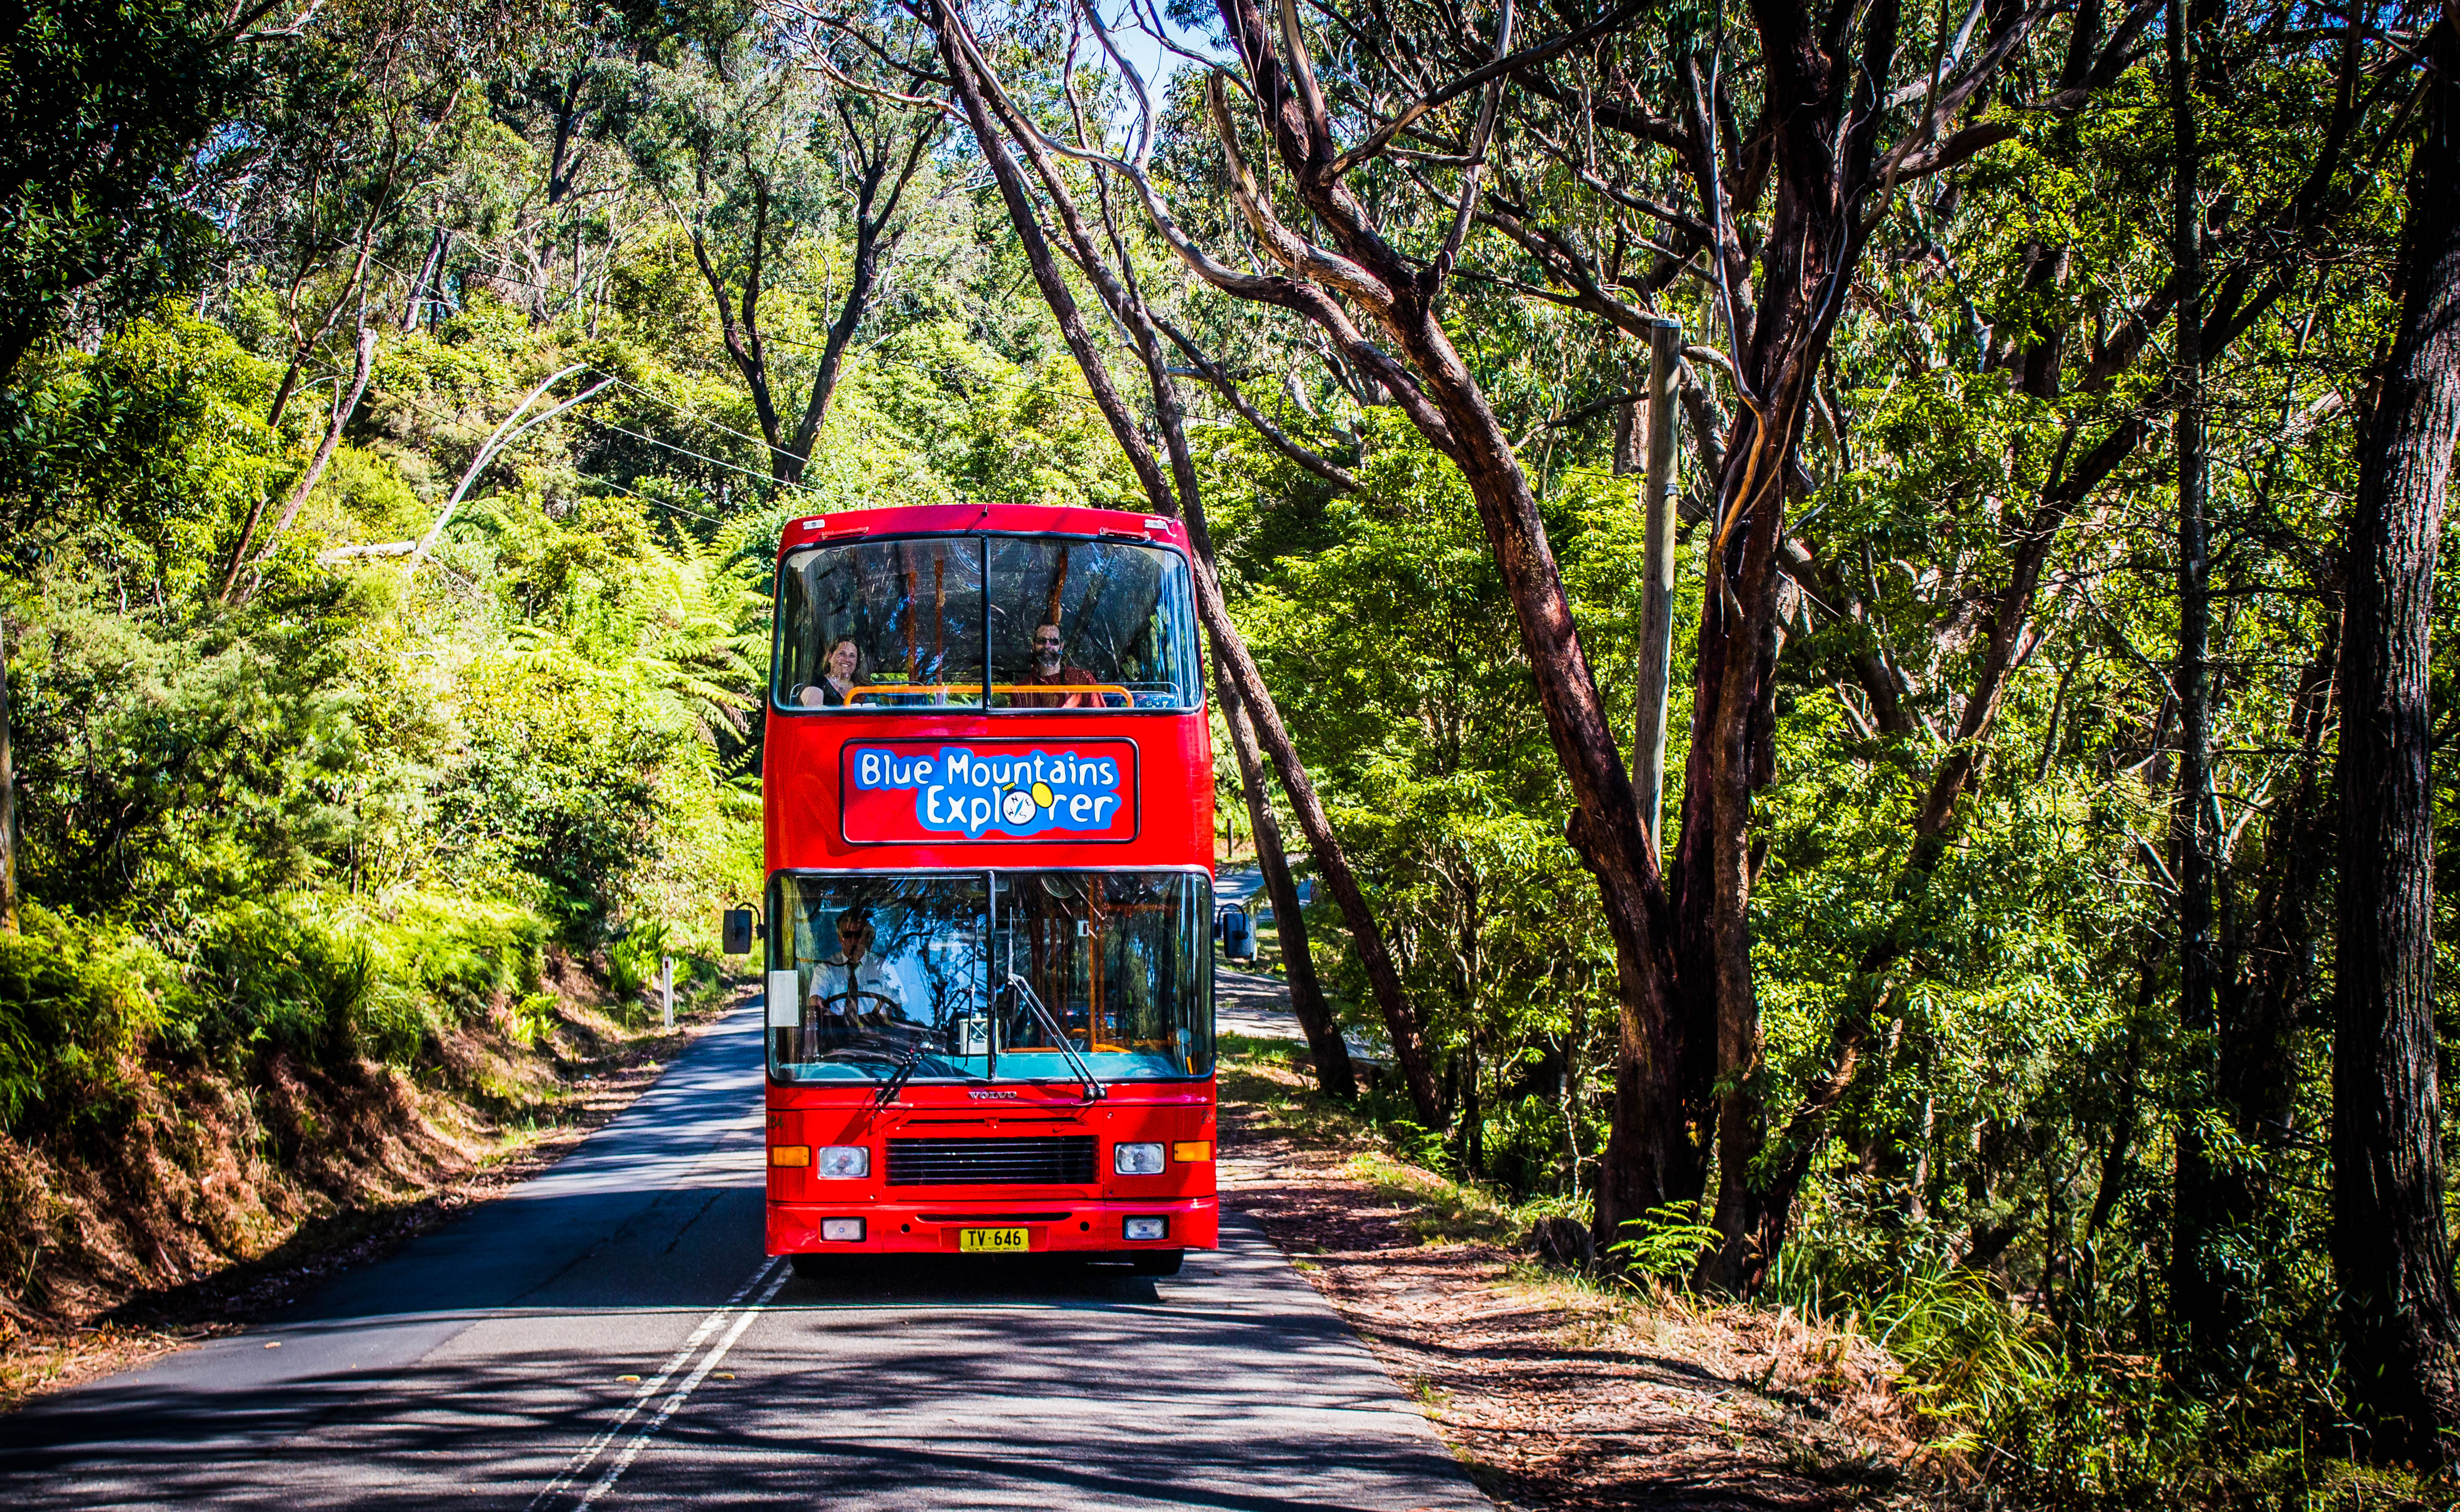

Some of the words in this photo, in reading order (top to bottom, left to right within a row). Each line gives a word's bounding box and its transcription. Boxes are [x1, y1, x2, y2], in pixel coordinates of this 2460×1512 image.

[862, 754, 933, 785] Blue
[948, 754, 1114, 787] Mountains
[1011, 795, 1018, 804] N
[1006, 807, 1014, 816] W
[1019, 811, 1026, 819] S
[968, 1091, 1017, 1099] VOLVO
